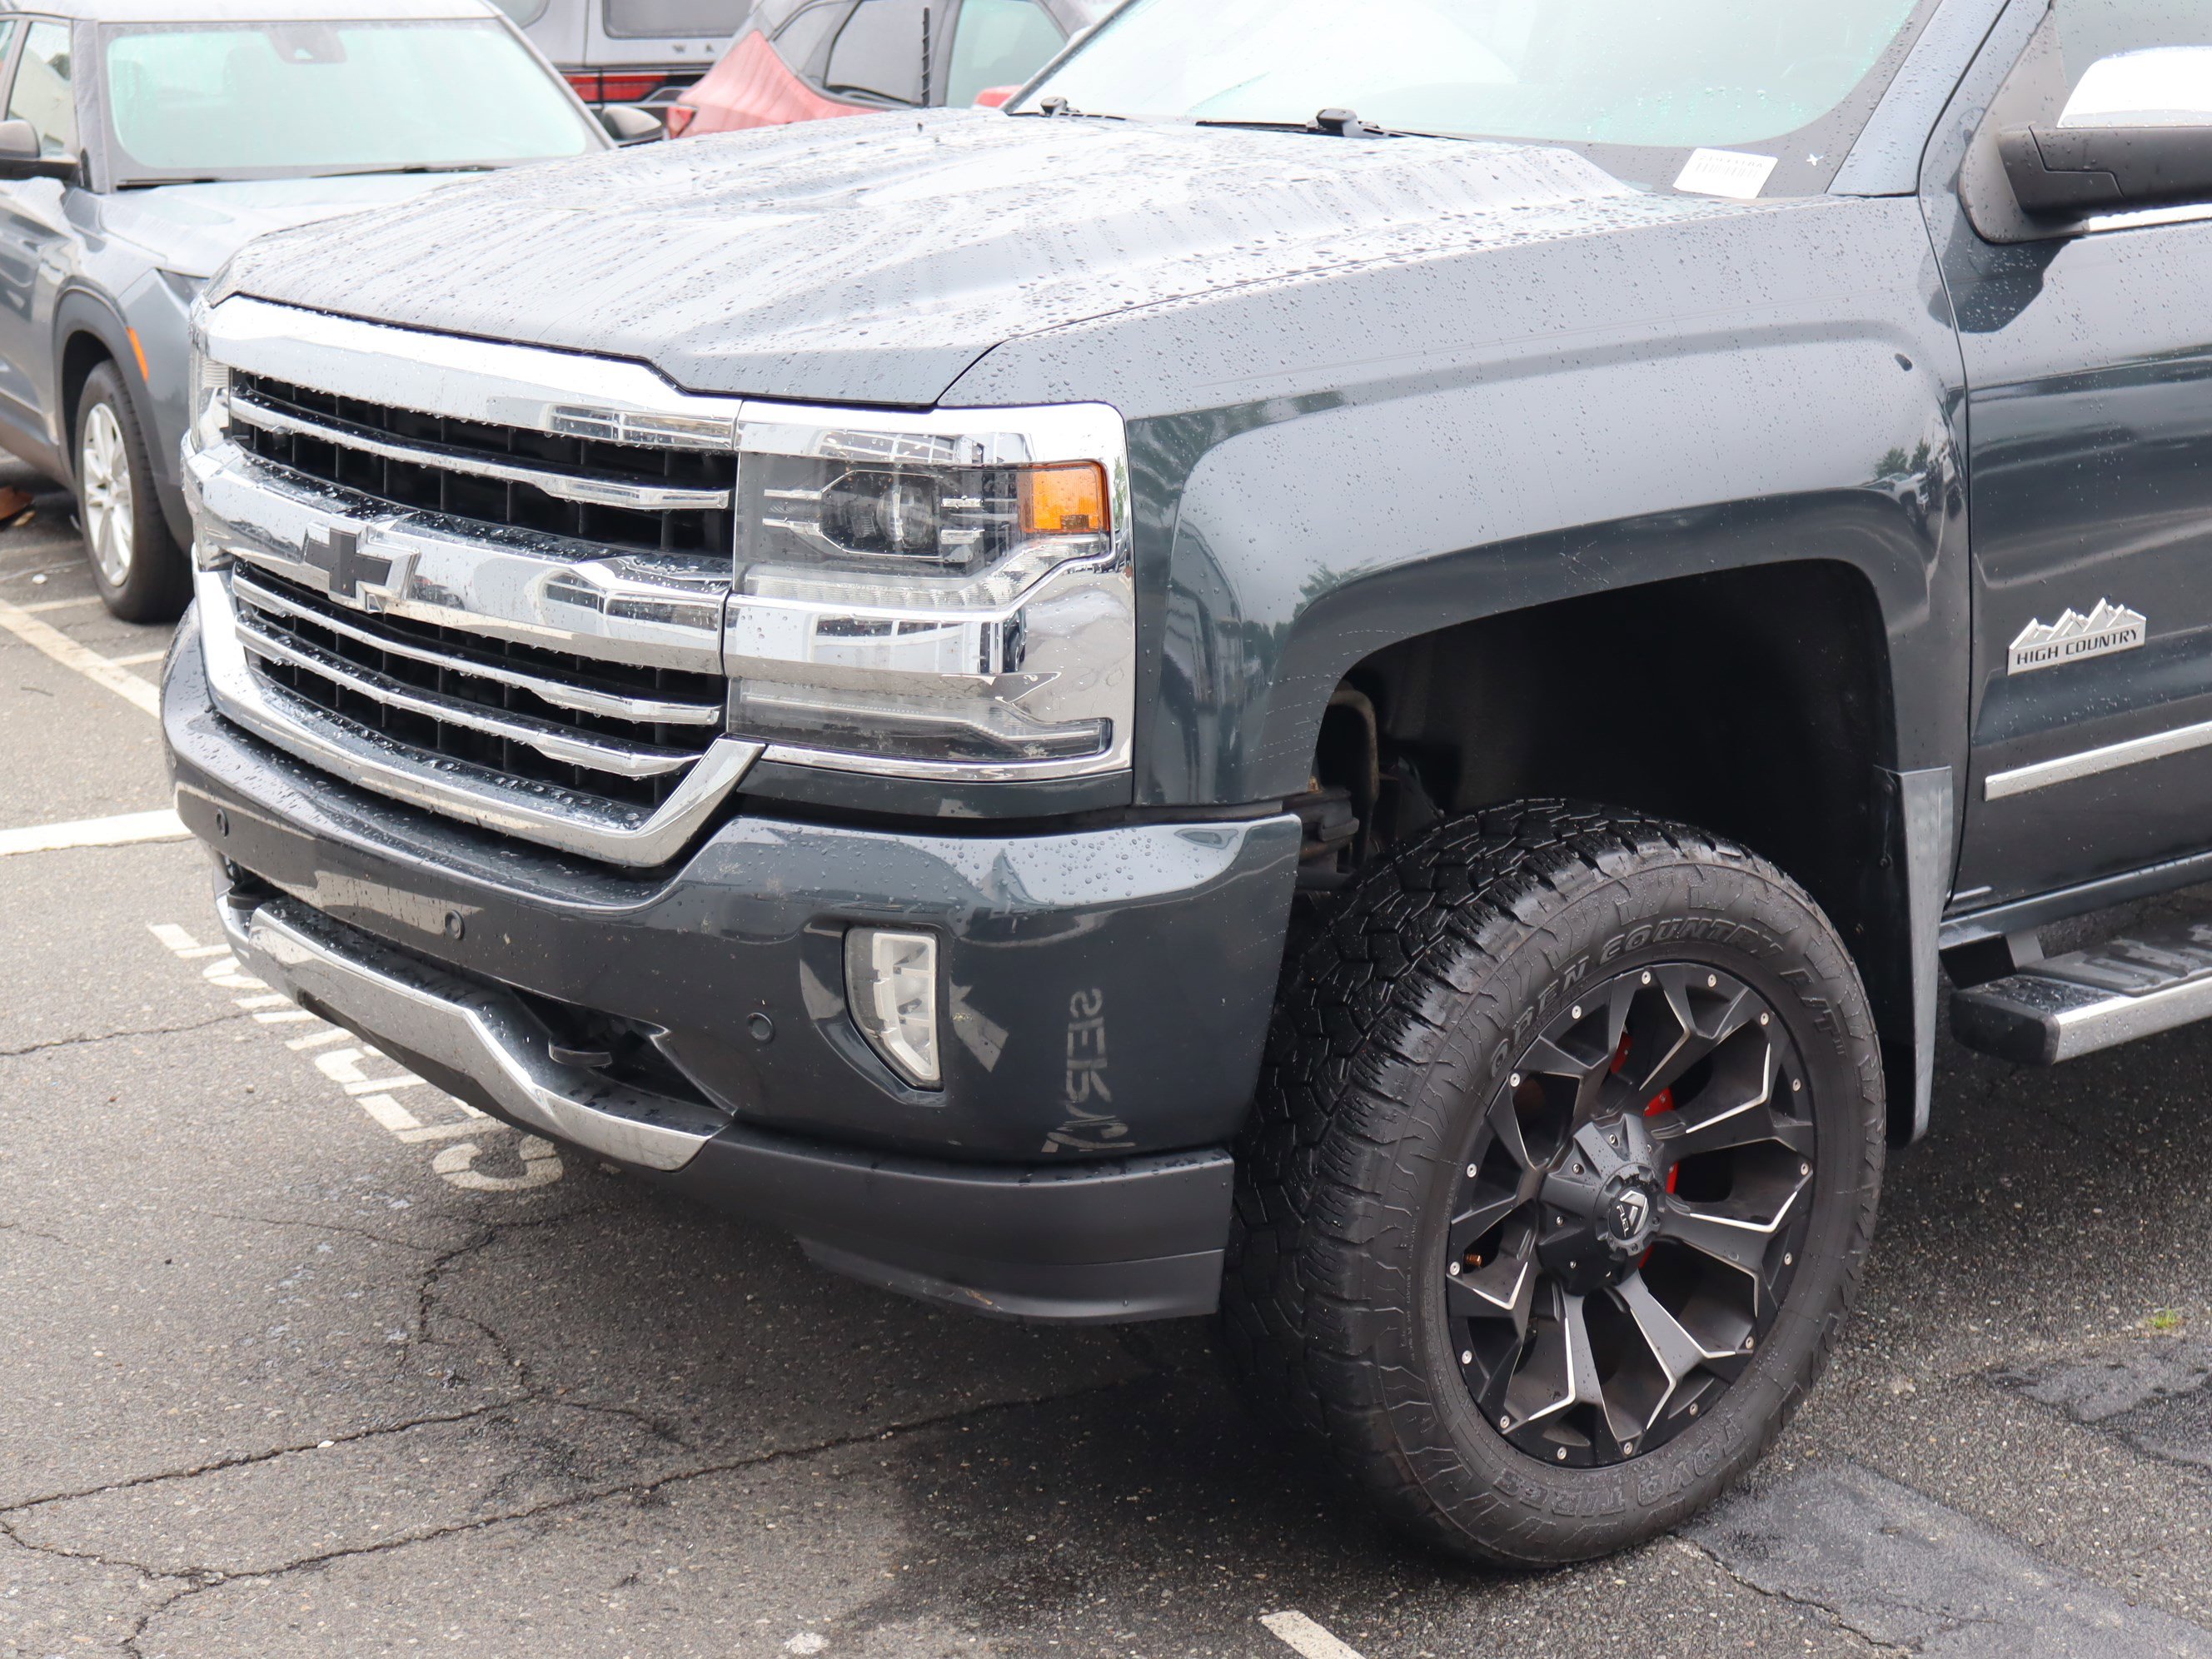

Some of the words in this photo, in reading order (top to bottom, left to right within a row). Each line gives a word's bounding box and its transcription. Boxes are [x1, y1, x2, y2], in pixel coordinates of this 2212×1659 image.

[2016, 645, 2059, 666] HIGH
[2065, 628, 2140, 656] COUNTRY
[1491, 955, 1590, 1079] OPEN
[1599, 917, 1785, 964] COUNTRY
[1616, 1203, 1630, 1238] FUEL
[1636, 1419, 1746, 1507] TOYO
